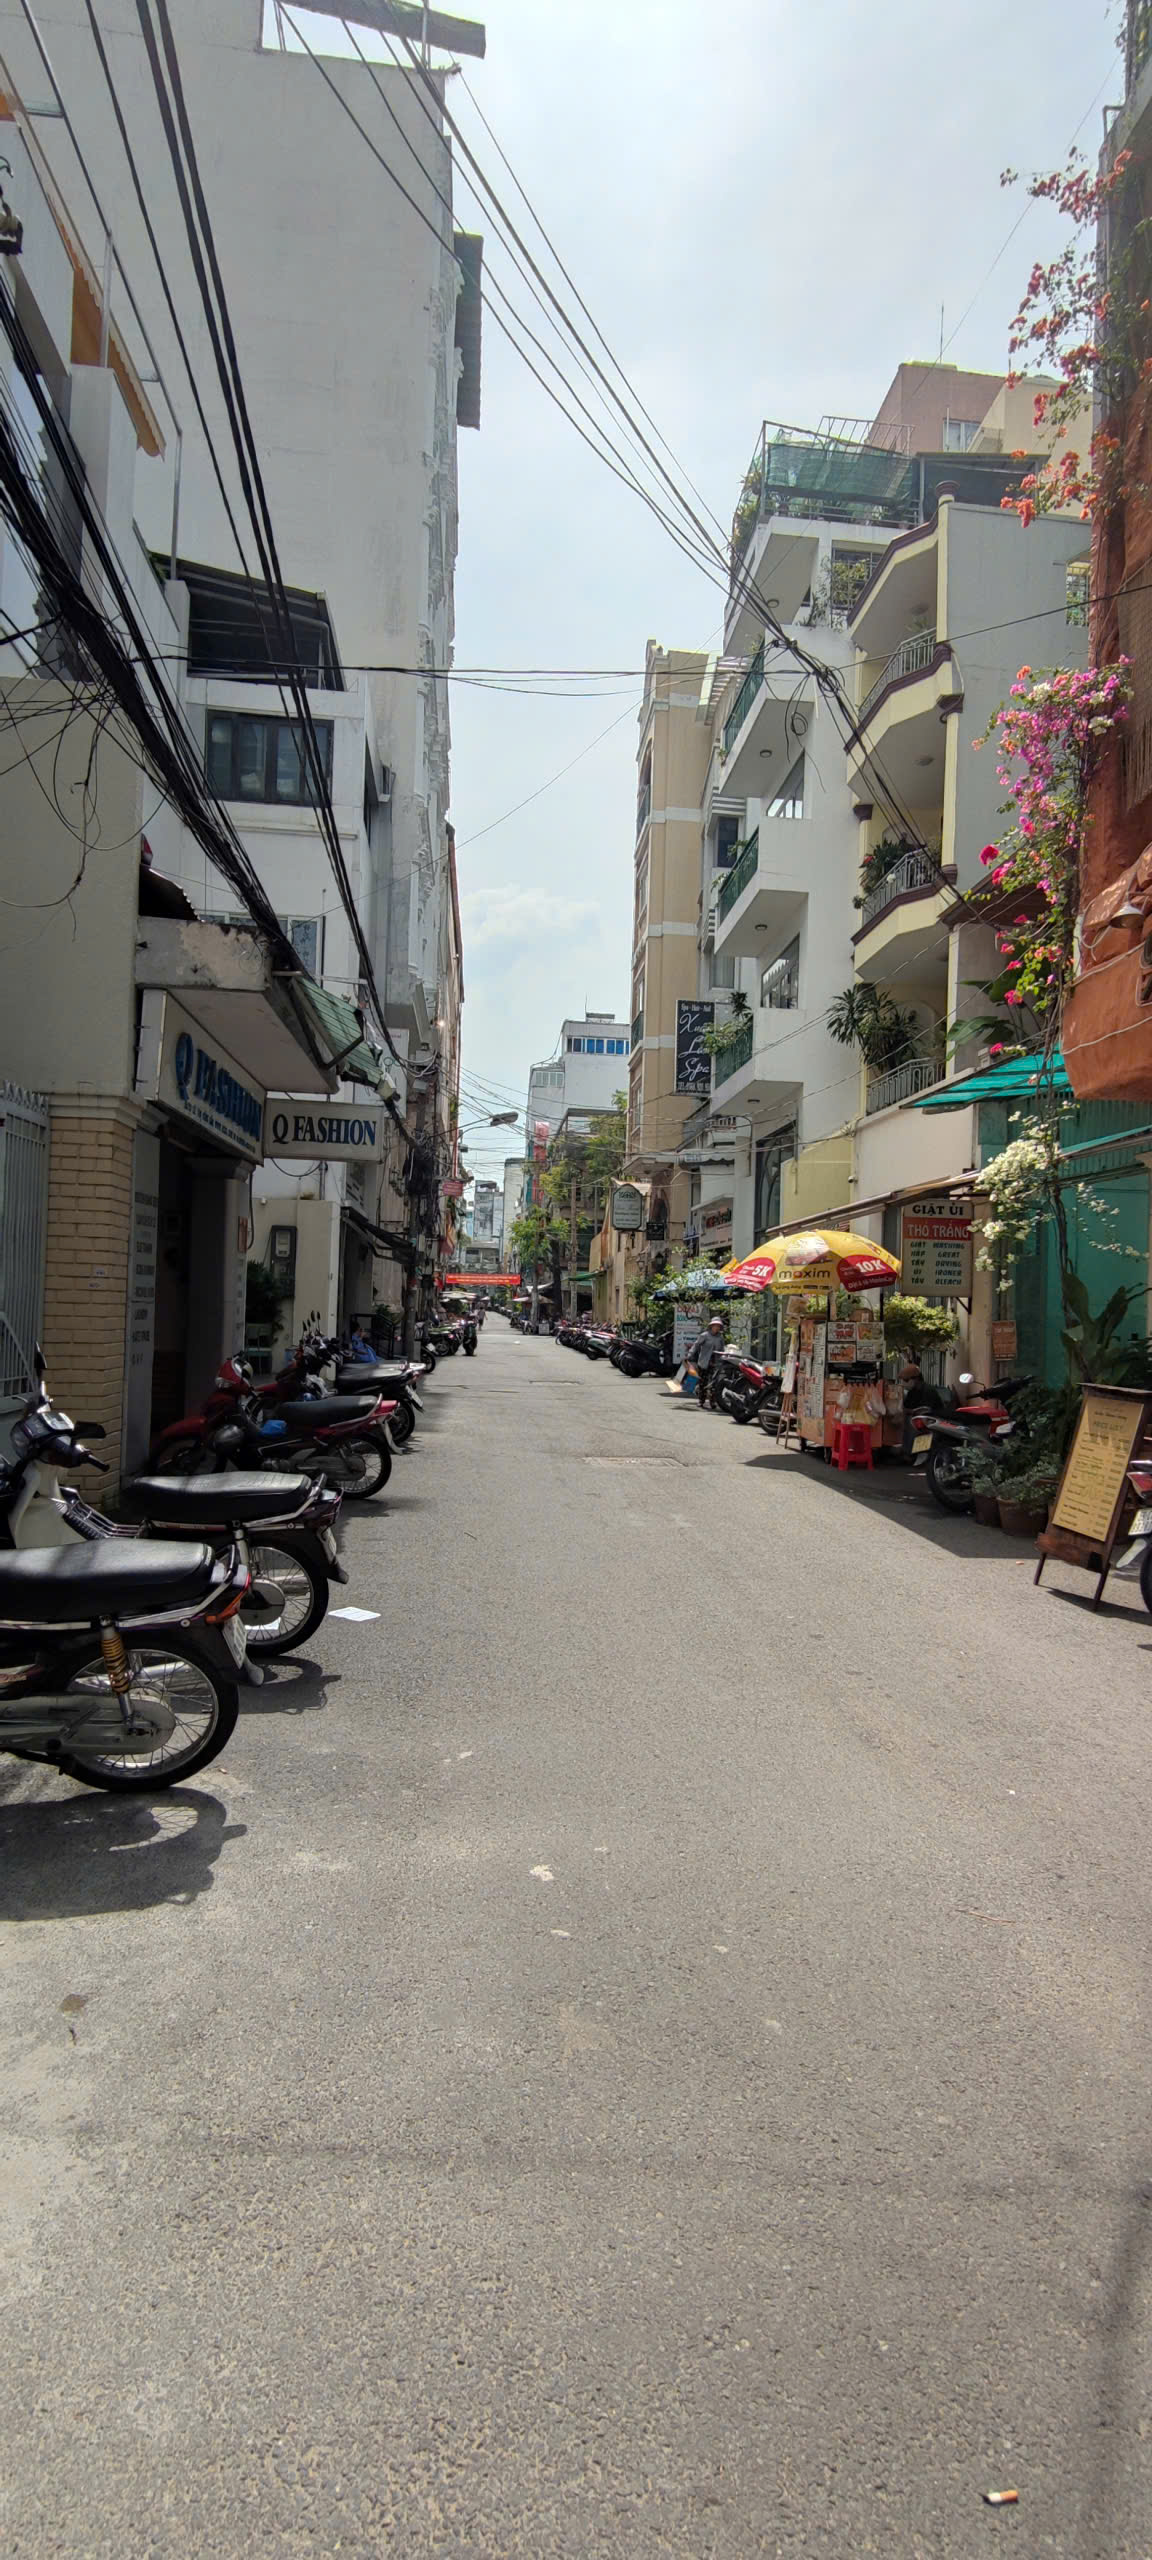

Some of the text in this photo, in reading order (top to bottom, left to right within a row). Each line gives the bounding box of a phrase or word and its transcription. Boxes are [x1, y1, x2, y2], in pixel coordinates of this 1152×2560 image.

[679, 1057, 710, 1081] Spa
[176, 1031, 193, 1101] Q
[194, 1048, 262, 1142] FASHION
[272, 1113, 289, 1144] Q
[292, 1115, 376, 1146] FASHION
[912, 1202, 964, 1216] GIẶT ỦI
[751, 1265, 772, 1277] 5K
[856, 1259, 885, 1273] 10K
[778, 1269, 831, 1279] maxim
